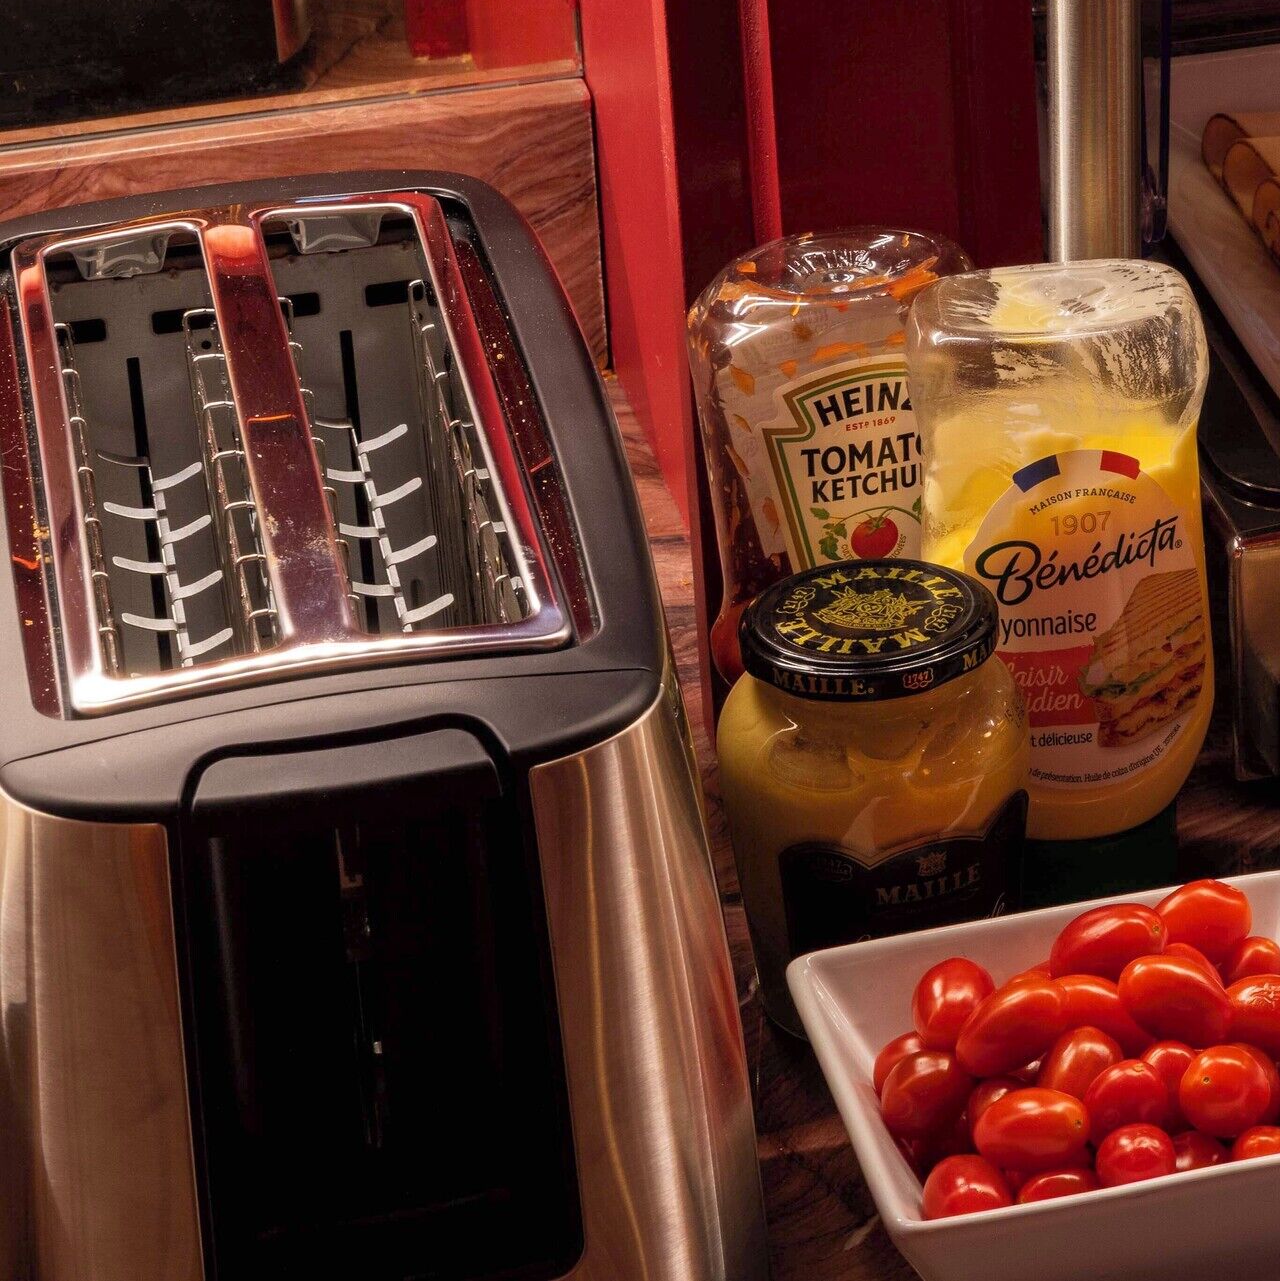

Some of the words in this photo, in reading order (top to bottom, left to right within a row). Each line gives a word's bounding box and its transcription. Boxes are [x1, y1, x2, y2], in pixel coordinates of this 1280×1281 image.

[872, 416, 896, 428] 1869
[800, 431, 921, 478] TOMAT
[812, 462, 922, 504] KETCHU
[1029, 490, 1073, 516] MAISON
[1075, 488, 1137, 505] FRANÇAISE
[1050, 510, 1112, 537] 1907
[975, 515, 1179, 606] Bénédicta
[813, 567, 963, 606] MAILLE
[775, 618, 931, 654] MAILLE
[1000, 609, 1097, 646] yonnaise
[772, 670, 868, 696] MAILLE
[907, 670, 929, 684] 1747
[1010, 662, 1070, 688] aisir
[1026, 687, 1084, 714] idien
[1038, 730, 1094, 748] délicieuse
[876, 861, 981, 905] MAILLE
